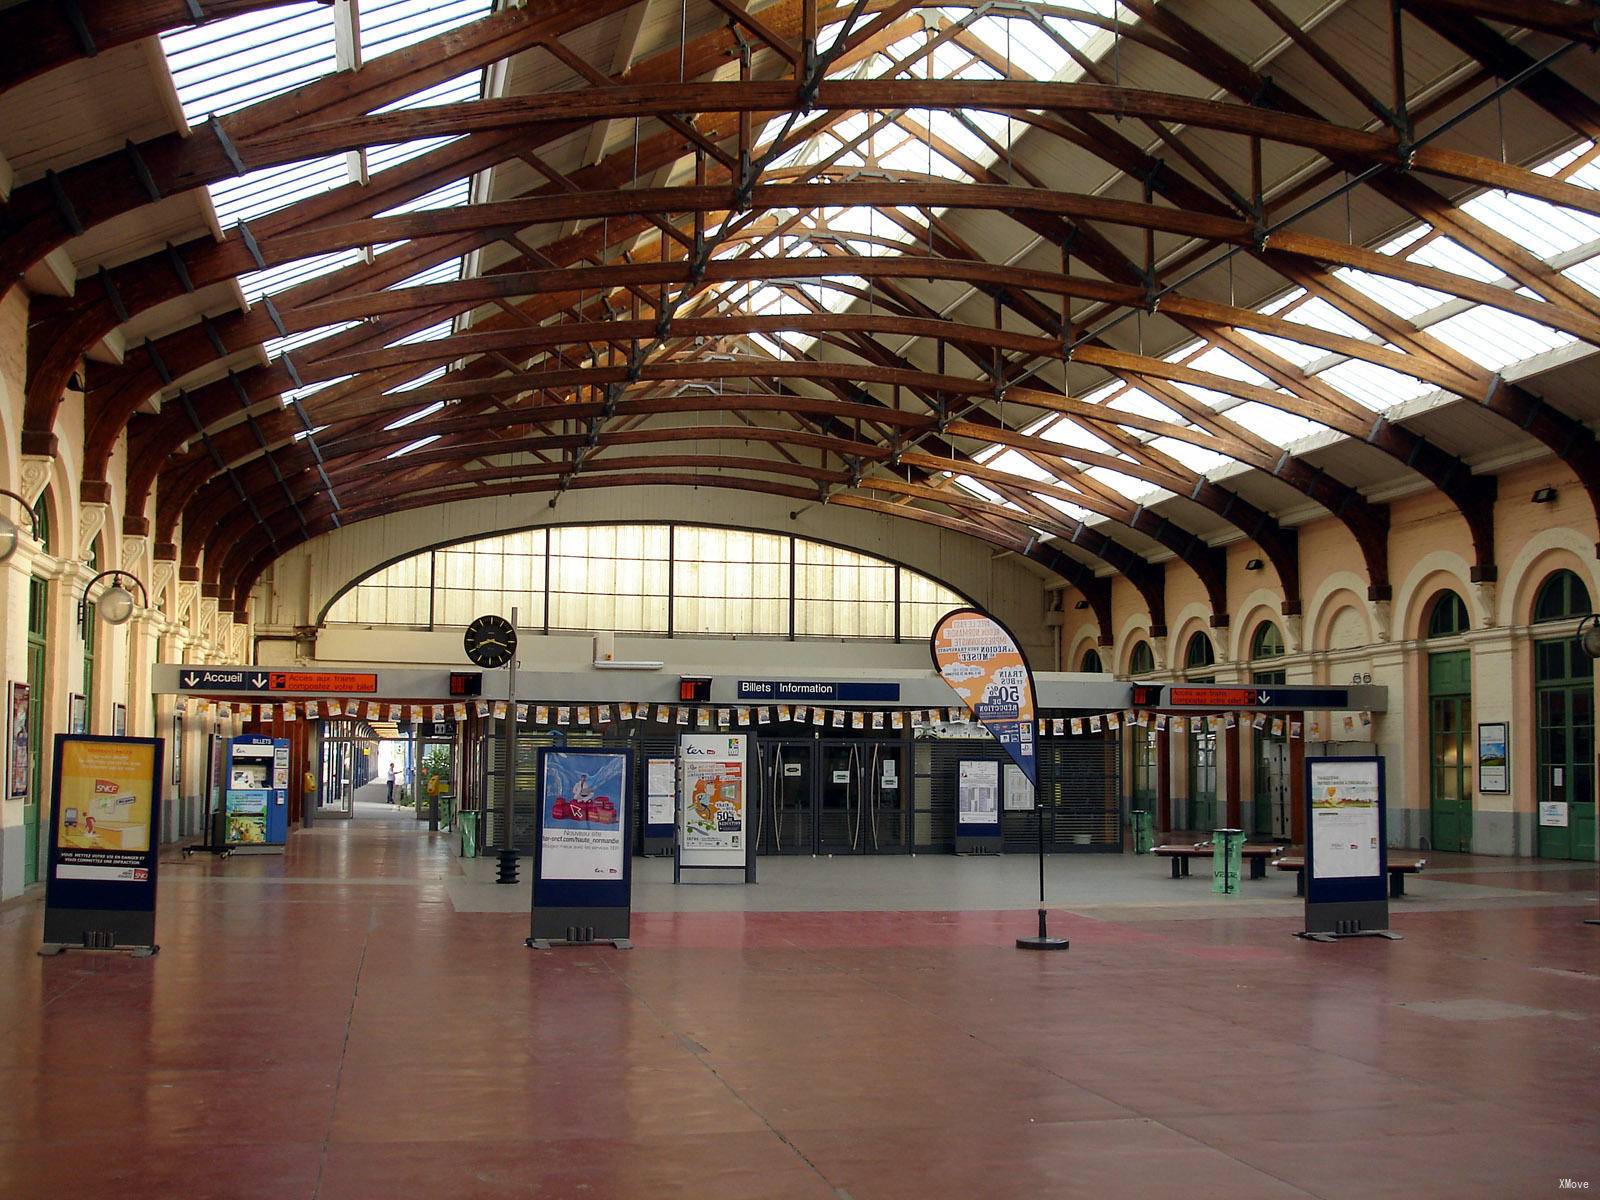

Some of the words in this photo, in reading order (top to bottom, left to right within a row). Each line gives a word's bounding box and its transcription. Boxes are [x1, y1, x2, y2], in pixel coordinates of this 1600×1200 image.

[203, 672, 243, 683] Accueil
[741, 682, 772, 692] Billets
[779, 683, 833, 693] Information
[686, 744, 705, 754] ter
[96, 784, 117, 793] SNCF
